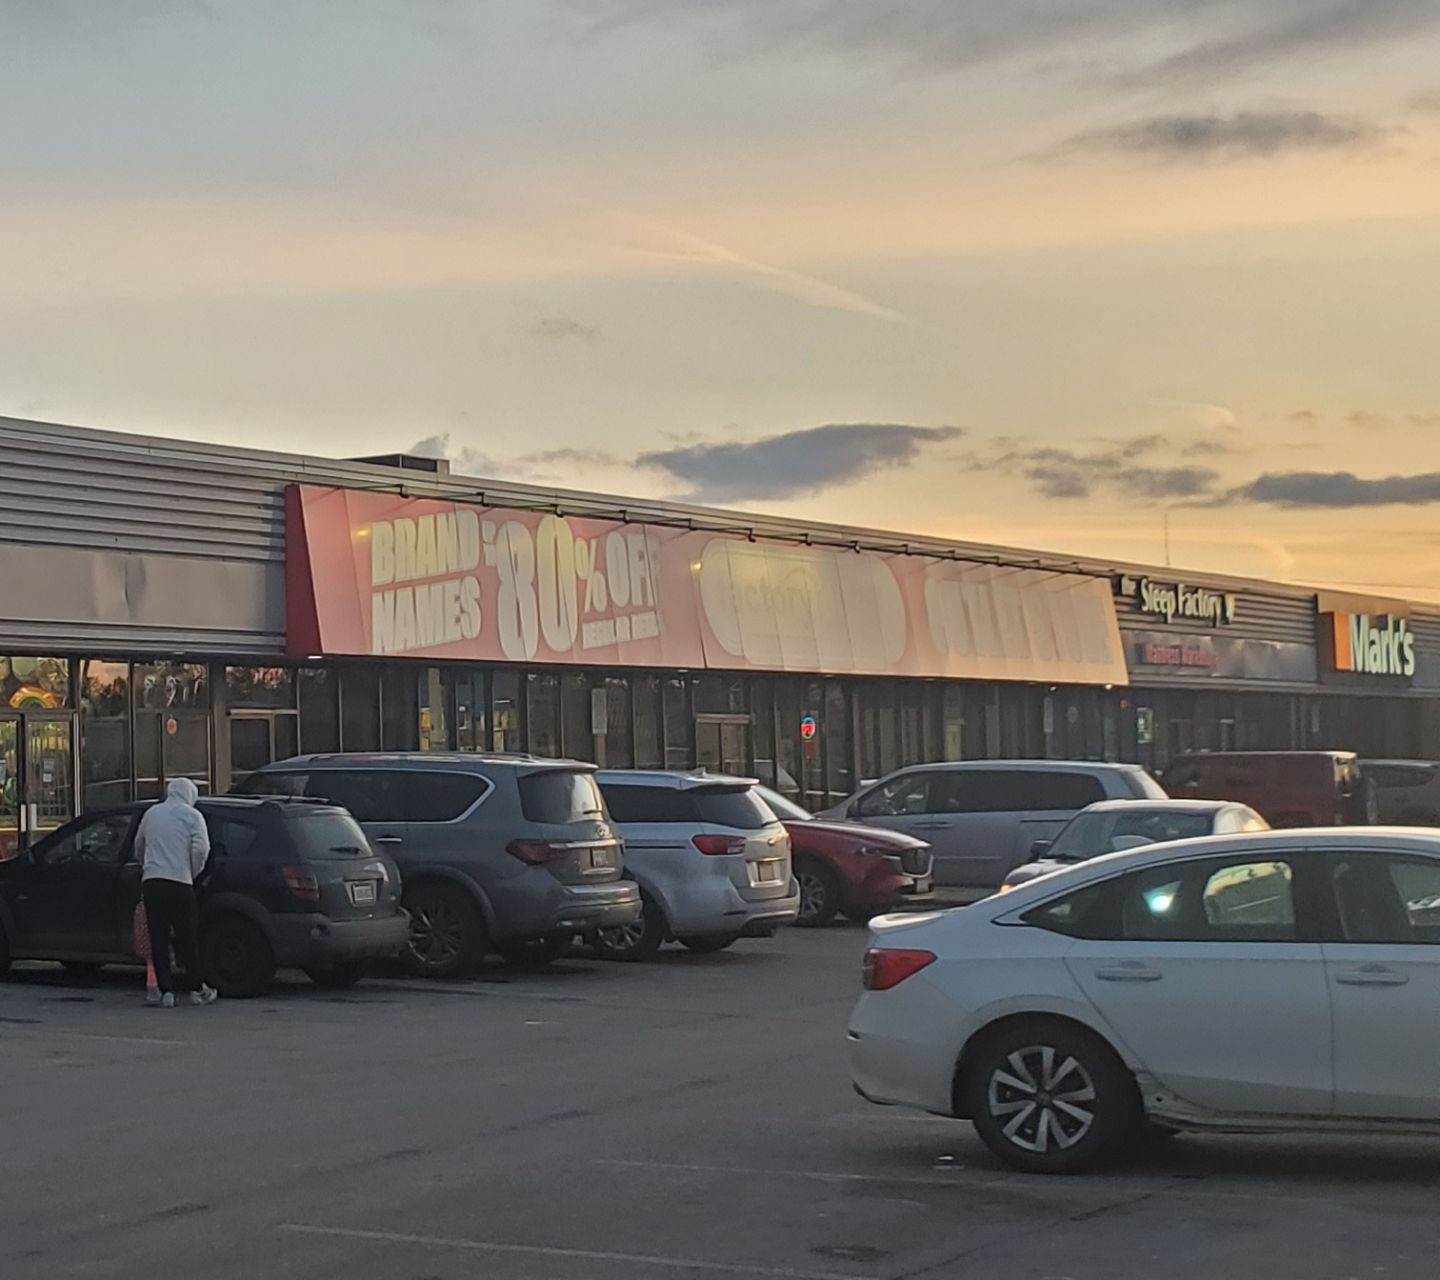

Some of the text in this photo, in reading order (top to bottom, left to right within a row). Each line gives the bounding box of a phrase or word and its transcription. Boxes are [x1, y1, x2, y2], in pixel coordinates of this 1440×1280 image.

[371, 509, 480, 587] BRAND
[371, 575, 482, 656] NAMES
[1140, 577, 1176, 625] Sleep
[1176, 583, 1224, 628] Factory
[1350, 613, 1416, 676] Mark's
